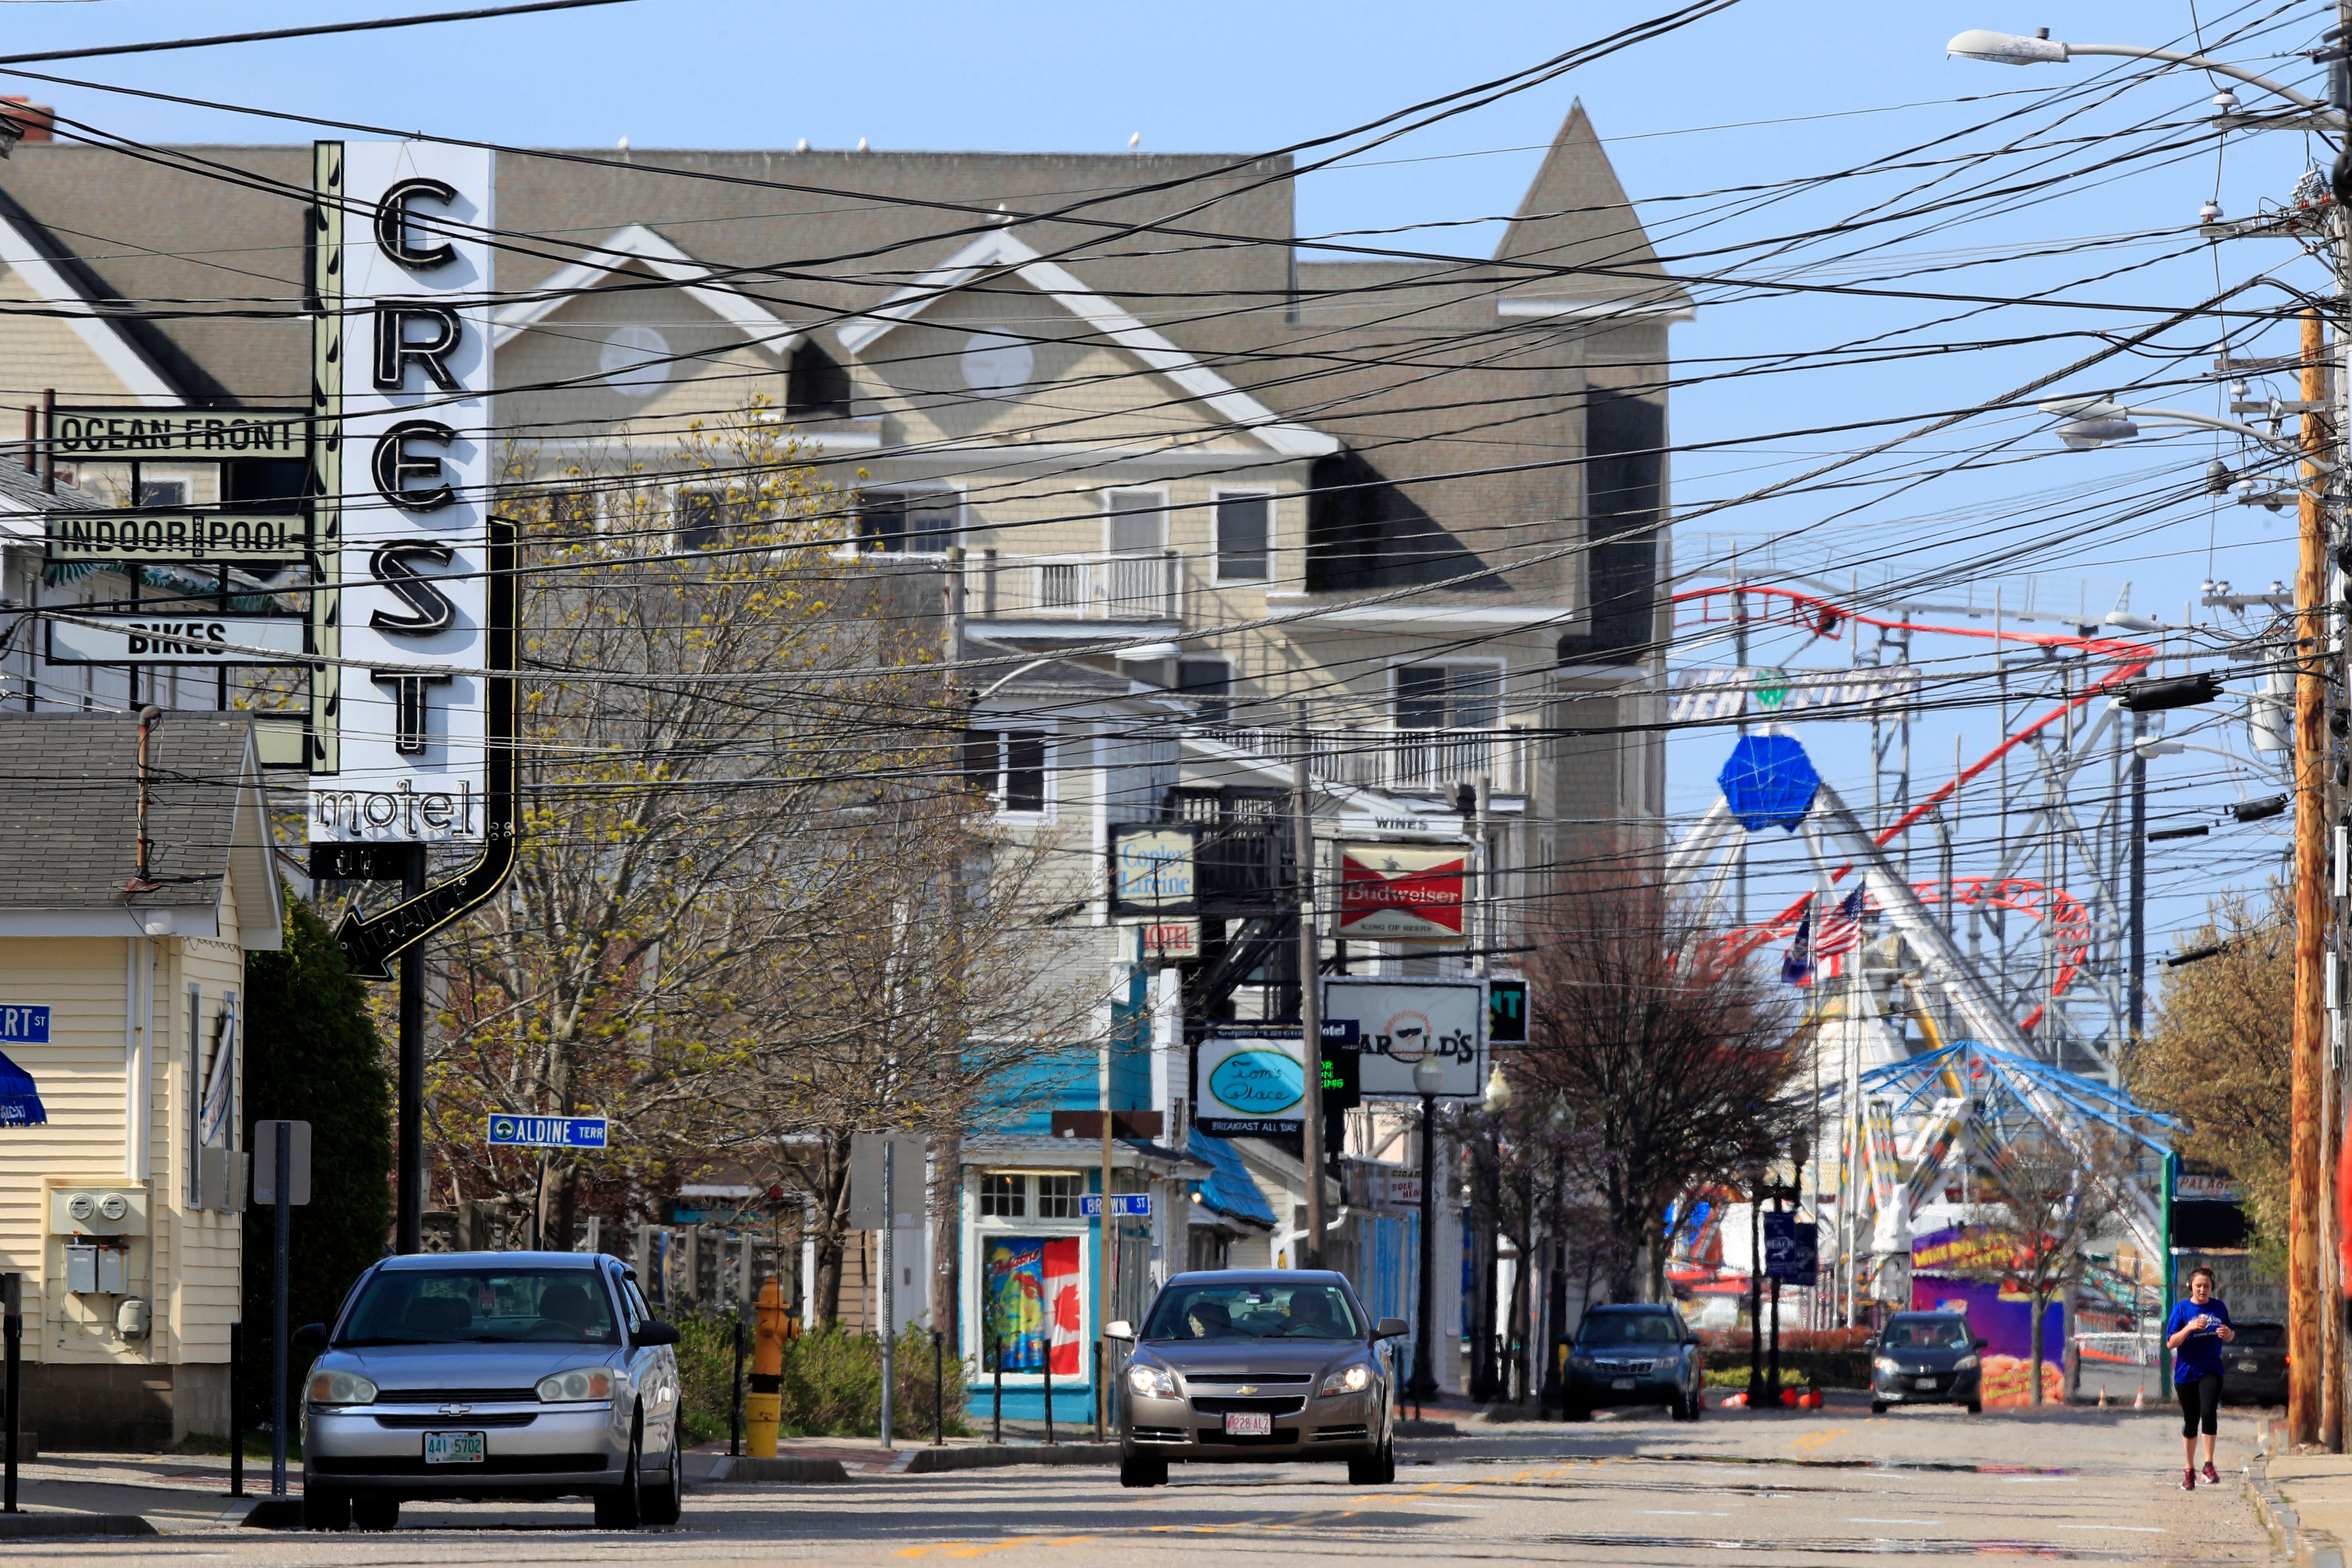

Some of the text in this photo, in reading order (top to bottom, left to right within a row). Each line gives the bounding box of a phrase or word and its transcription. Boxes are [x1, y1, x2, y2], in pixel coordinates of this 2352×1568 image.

[62, 418, 297, 450] OCEAN FRONT
[369, 176, 462, 755] CREST
[62, 520, 186, 553] INDOOR
[210, 521, 294, 553] POOL
[128, 622, 226, 655] BIKES
[311, 779, 473, 838] motel
[1374, 816, 1429, 831] WINES
[1123, 842, 1186, 874] Copley
[1346, 881, 1459, 903] Budweiser
[348, 882, 473, 962] NTRANCE
[34, 1016, 46, 1026] ST
[1320, 1024, 1345, 1036] otel
[1230, 1060, 1281, 1080] Tom's
[1223, 1083, 1291, 1100] Place
[516, 1119, 604, 1143] ALDINE TERR
[1211, 1121, 1298, 1132] BREAKFAST ALL DAY
[1391, 1181, 1413, 1191] SOLD
[1087, 1197, 1145, 1213] BRWN ST
[454, 1439, 481, 1453] 5702
